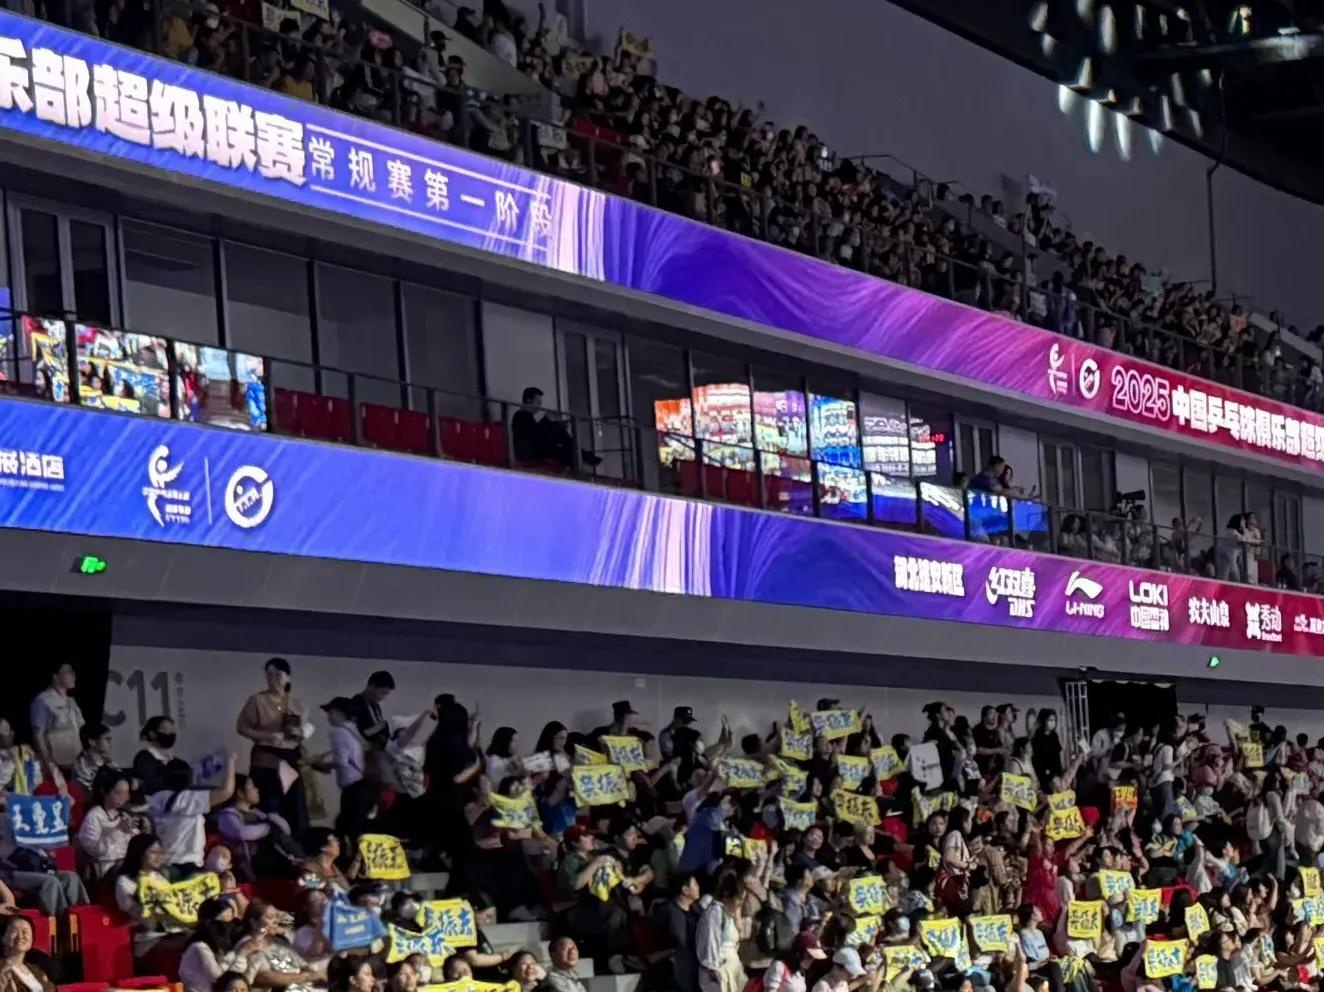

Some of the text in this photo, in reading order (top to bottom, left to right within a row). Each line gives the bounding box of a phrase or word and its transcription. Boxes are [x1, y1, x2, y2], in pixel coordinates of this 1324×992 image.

[309, 136, 552, 236] 常规赛第一阶段
[1112, 365, 1171, 422] 2025
[988, 566, 1036, 599] 红双喜
[1129, 580, 1169, 606] LOKI
[1065, 600, 1105, 619] LI-NING
[1188, 596, 1231, 629] 农夫山泉
